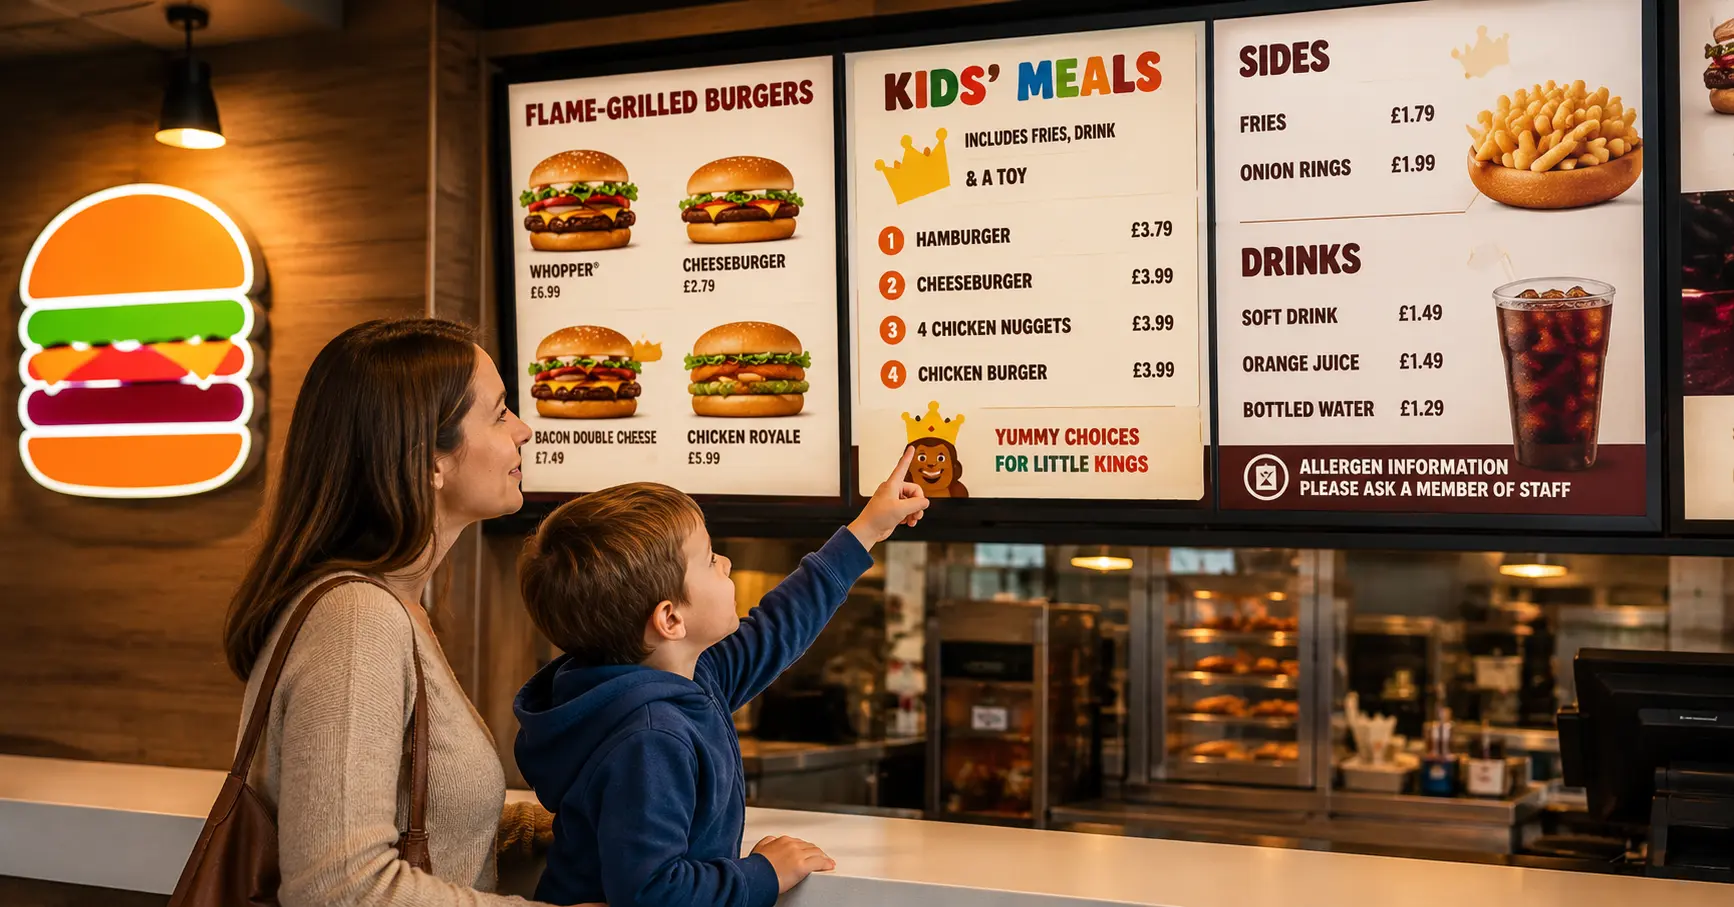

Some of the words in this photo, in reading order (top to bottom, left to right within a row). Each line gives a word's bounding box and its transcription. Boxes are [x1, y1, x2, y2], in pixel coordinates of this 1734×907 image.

[1240, 40, 1329, 77] SIDES
[1018, 51, 1161, 101] MEALS
[526, 90, 697, 126] FLAME-GRILLED
[705, 80, 813, 112] BURGERS
[1241, 114, 1286, 133] FRIES
[1391, 105, 1434, 123] £1.79
[965, 129, 1028, 148] INCLUDES
[1032, 126, 1071, 143] FRIES,
[1075, 123, 1115, 140] DRINK
[966, 171, 977, 187] &
[982, 170, 993, 185] A
[997, 167, 1027, 185] TOY
[1241, 162, 1294, 181] ONION
[1300, 159, 1351, 178] RINGS
[1392, 155, 1435, 173] £1.99
[887, 233, 895, 249] 1
[917, 228, 1010, 247] HAMBURGER
[1131, 221, 1172, 237] £3.79
[683, 254, 785, 272] CHEESEBURGER
[1242, 243, 1361, 277] DRINKS
[684, 279, 715, 293] £2.79
[888, 277, 896, 293] 2
[917, 273, 1032, 292] CHEESEBURGER
[1132, 268, 1173, 284] £3.99
[531, 286, 560, 299] £6.99
[1242, 309, 1282, 326] SOFT
[1287, 307, 1338, 324] DRINK
[1399, 304, 1442, 321] £1.49
[887, 322, 897, 339] 3
[918, 322, 927, 337] 4
[932, 320, 996, 337] CHICKEN
[1001, 318, 1071, 335] NUGGETS
[1133, 315, 1173, 331] £3.99
[888, 366, 898, 382] 4
[919, 365, 982, 382] CHICKEN
[988, 364, 1047, 380] BURGER
[1133, 362, 1174, 378] £3.99
[1243, 355, 1308, 372] ORANGE
[1313, 354, 1359, 371] JUICE
[1400, 353, 1443, 369] £1.49
[1244, 401, 1314, 417] BOTTLED
[1319, 401, 1374, 417] WATER
[1401, 400, 1444, 416] £1.29
[535, 431, 570, 444] BACON
[574, 431, 613, 444] DOUBLE
[617, 431, 656, 444] CHEESE
[688, 430, 745, 444] CHICKEN
[750, 430, 800, 444] ROYALE
[995, 428, 1060, 445] YUMMY
[1065, 428, 1139, 445] CHOICES
[536, 452, 564, 464] £7.49
[689, 452, 720, 464] £5.99
[996, 455, 1028, 472] FOR
[1034, 455, 1089, 472] LITTLE
[1095, 455, 1148, 473] KINGS
[1300, 459, 1382, 474] ALLERGEN
[1389, 459, 1508, 475] INFORMATION
[1301, 481, 1358, 496] PLEASE
[1364, 481, 1396, 496] ASK
[1400, 481, 1412, 496] A
[1417, 482, 1488, 497] MEMBER
[1493, 482, 1515, 497] OF
[1520, 482, 1571, 497] STAFF
